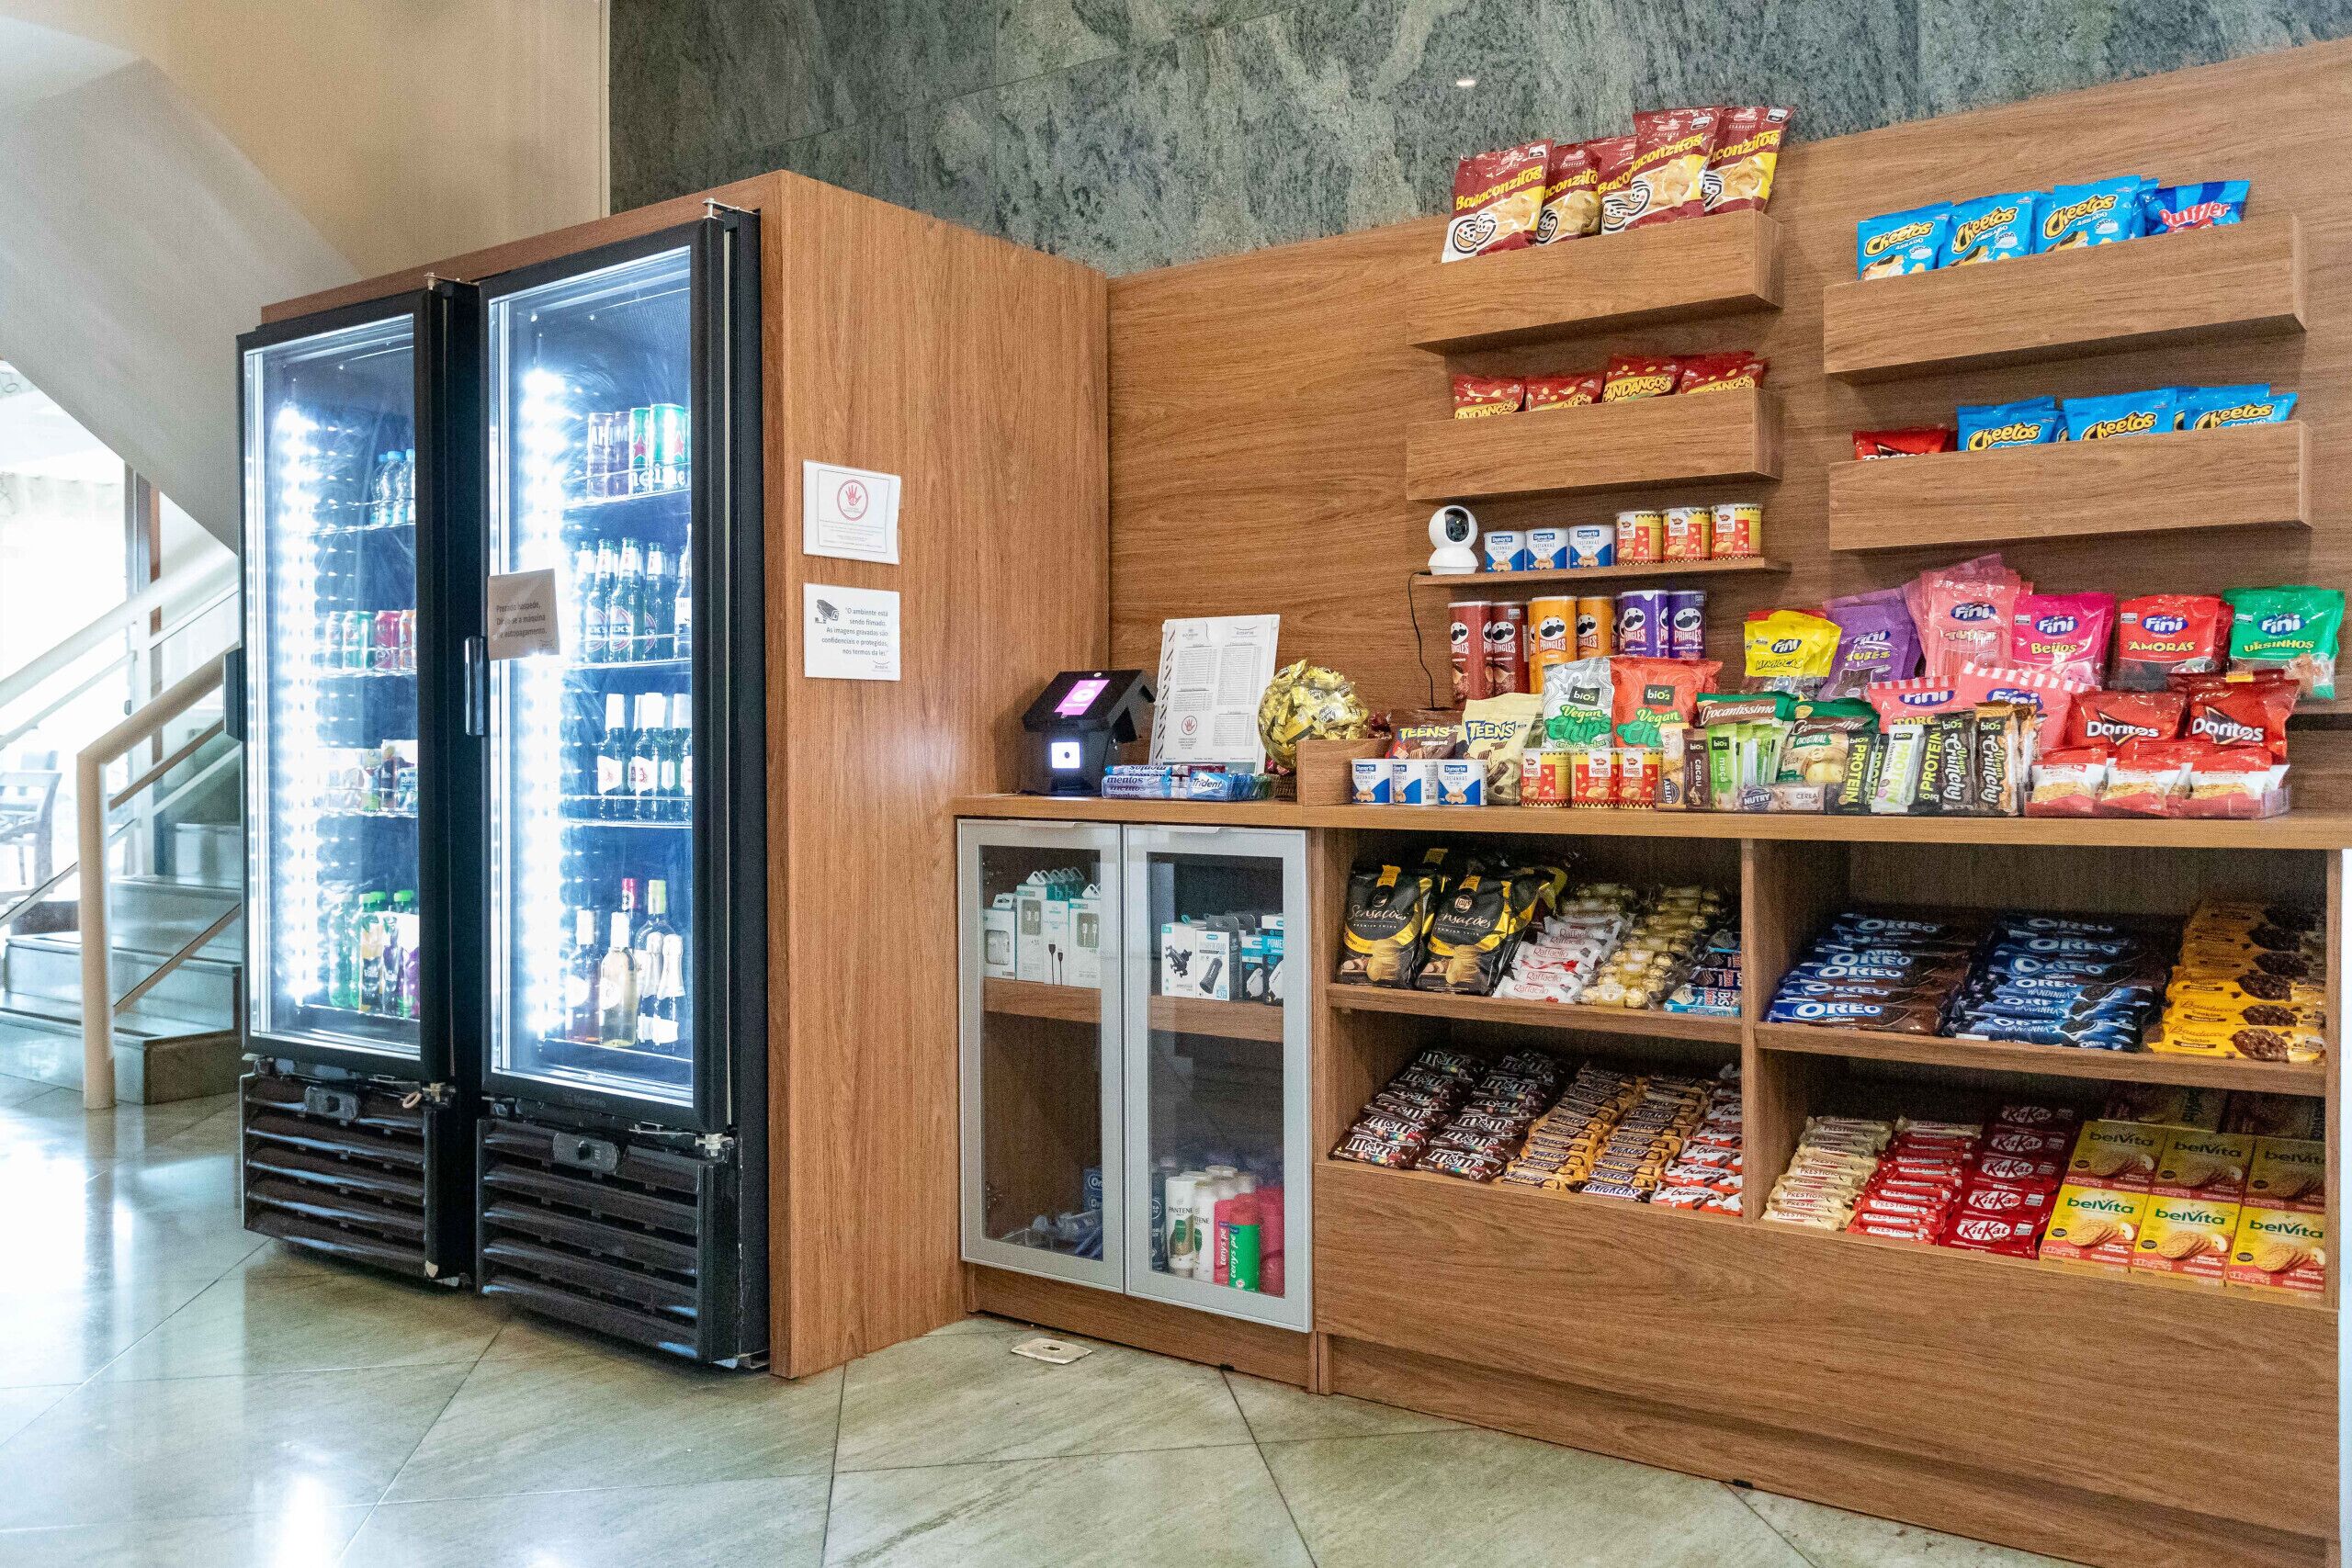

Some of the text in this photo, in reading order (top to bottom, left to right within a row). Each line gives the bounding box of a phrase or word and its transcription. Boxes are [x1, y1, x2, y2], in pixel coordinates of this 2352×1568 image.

[2044, 196, 2117, 238] Cheetos
[2159, 202, 2230, 227] Ruffles
[1865, 222, 1934, 254] Cheetos
[1953, 209, 2018, 252] Cheetos
[2081, 412, 2156, 441] Cheetos
[2194, 404, 2275, 431] Cheetos
[1968, 423, 2041, 451] Cheetos
[1953, 604, 1991, 622] Fini
[834, 627, 855, 636] imagens
[2038, 615, 2075, 634] Fini
[2144, 615, 2184, 632] Fini
[2261, 614, 2301, 634] Fini
[821, 637, 855, 645] confidenciais
[1539, 637, 1566, 651] PRINGLES
[1674, 630, 1702, 642] PRINGLES
[1772, 639, 1801, 653] Fini
[2128, 640, 2196, 652] AMORAS
[1562, 705, 1603, 723] Vegan
[1636, 707, 1681, 728] Vegan
[1701, 704, 1776, 727] Crocantissimo
[1399, 726, 1450, 741] TEENS
[1466, 720, 1517, 742] TEENS
[1545, 716, 1612, 745] Chips
[2086, 720, 2159, 738] Doritos
[2191, 717, 2265, 742] Doritos
[1795, 734, 1826, 746] ORIGINAL
[1920, 731, 1942, 793] PROTEIN
[1942, 732, 1963, 802] Crunchy
[1980, 735, 2003, 805] Crunchy
[1106, 776, 1144, 784] mentos
[1694, 759, 1702, 787] cacau
[1846, 744, 1868, 804] PROTEIN
[1193, 777, 1223, 789] Trident
[1744, 793, 1771, 806] NUTRY
[1532, 946, 1569, 958] Raffaello
[1830, 953, 1912, 966] OREO
[1818, 965, 1903, 978] OREO
[2014, 957, 2104, 976] OREO
[1525, 971, 1563, 983] Raffaello
[2015, 978, 2078, 988] OREO
[1513, 984, 1549, 996] Raffaello
[1794, 1003, 1883, 1018] OREO
[1995, 1134, 2043, 1152] KitKat
[2089, 1131, 2154, 1147] belVita
[2174, 1141, 2242, 1158] belVita
[1984, 1159, 2032, 1178] KitKat
[1586, 1183, 1642, 1198] SNICKERS
[1971, 1190, 2022, 1210] KitKat
[2067, 1196, 2135, 1214] belVita
[2154, 1207, 2226, 1225] belVita
[1961, 1220, 2008, 1239] KitKat
[2248, 1219, 2324, 1239] belVita
